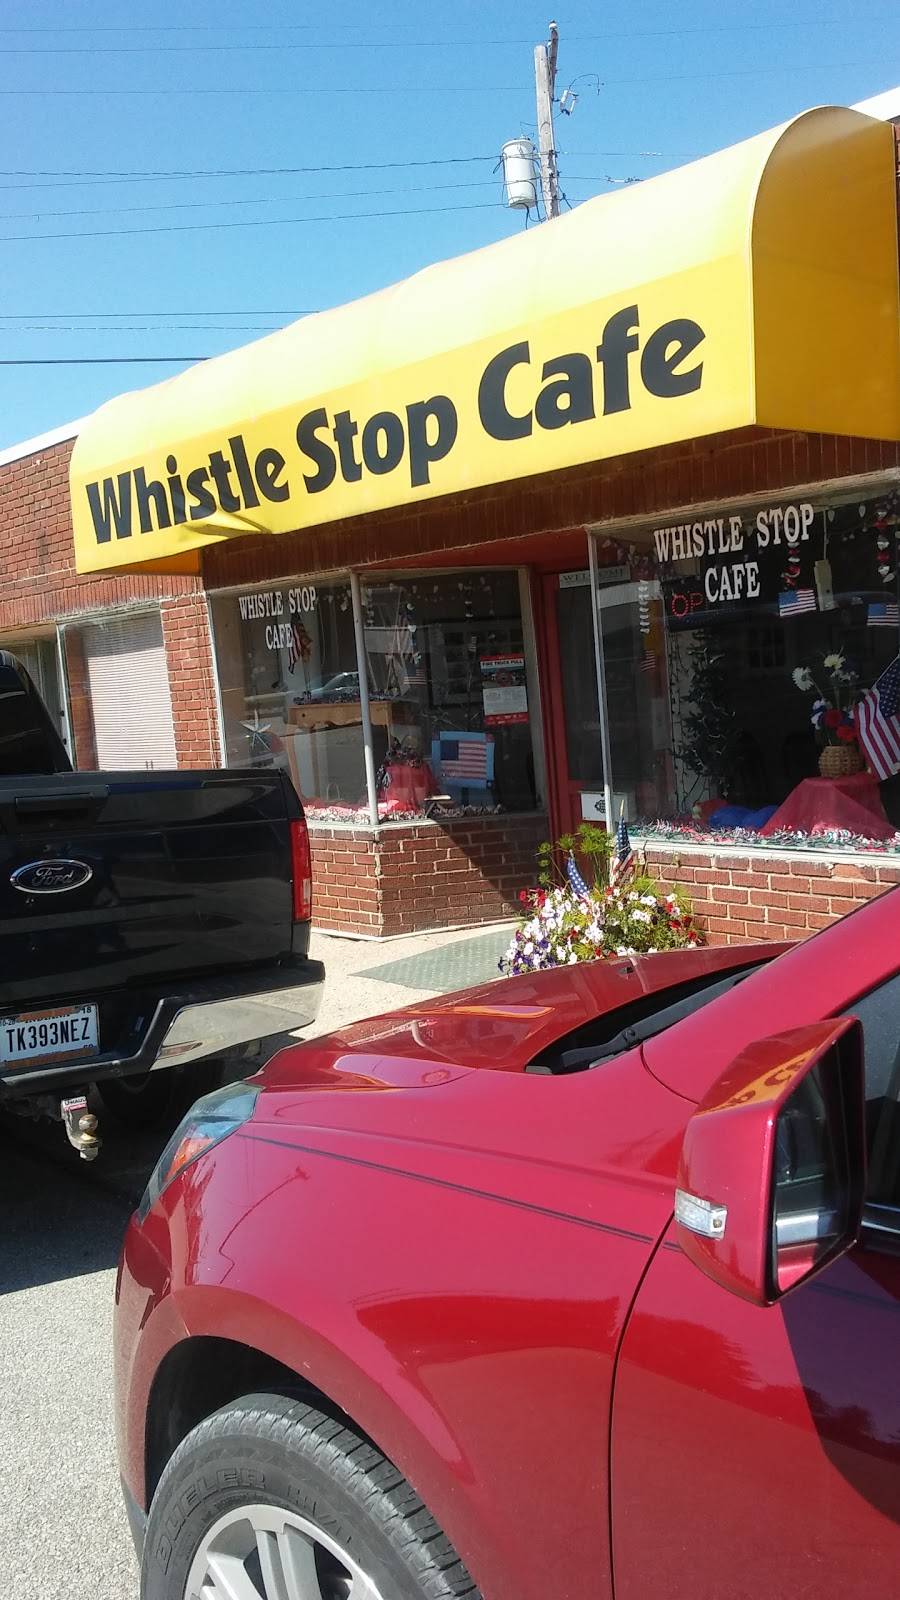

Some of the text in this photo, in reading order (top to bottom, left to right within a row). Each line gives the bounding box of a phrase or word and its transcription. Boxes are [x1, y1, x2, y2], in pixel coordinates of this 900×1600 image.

[86, 304, 706, 544] Whistle Stop Cafe
[653, 503, 814, 563] WHISTLE STOP
[704, 561, 760, 603] CAFE
[238, 586, 317, 620] WHISTLE STOP
[265, 623, 294, 650] CAFE
[32, 866, 75, 887] Ford
[6, 1017, 90, 1053] TK393NEZ
